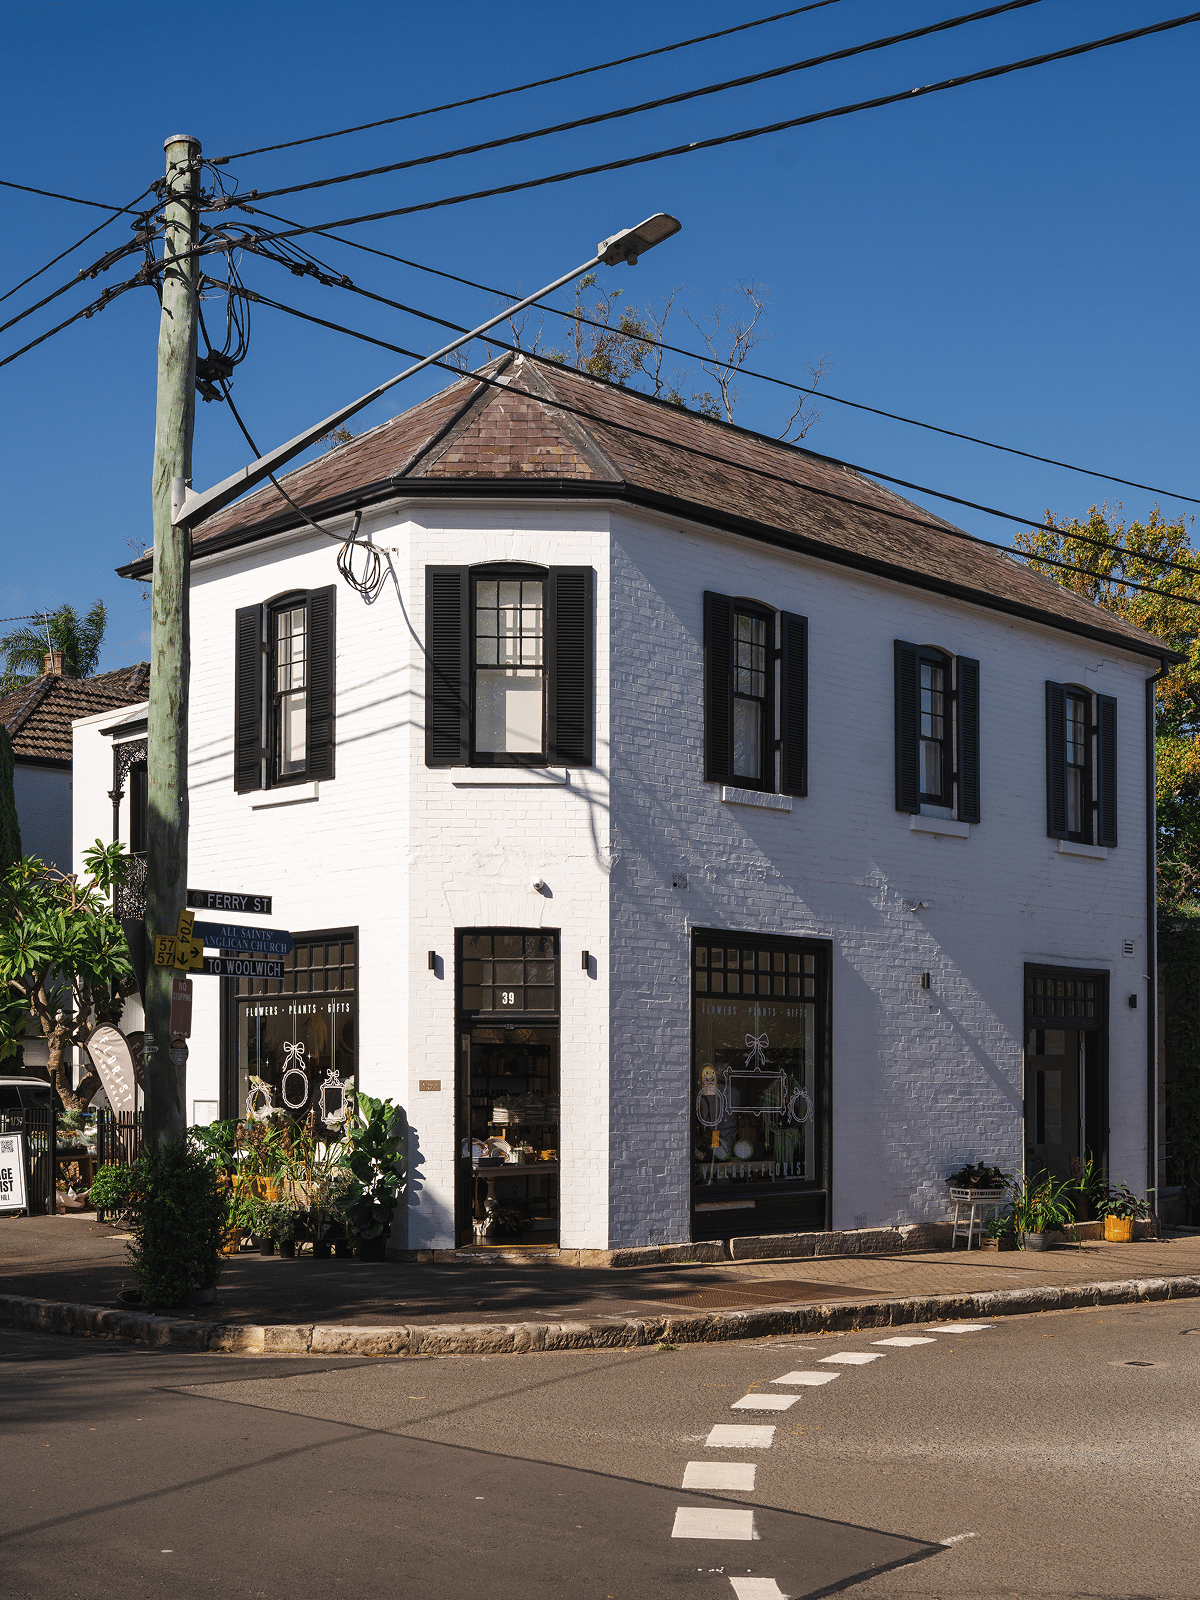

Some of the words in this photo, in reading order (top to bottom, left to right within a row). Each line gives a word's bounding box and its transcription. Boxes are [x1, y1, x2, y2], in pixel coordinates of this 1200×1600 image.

[207, 893, 248, 910] FERRY
[253, 897, 269, 912] ST
[180, 919, 193, 944] 704
[221, 926, 238, 937] ALL
[204, 935, 249, 950] ANGLICAN
[250, 939, 288, 953] CHURCH
[208, 959, 222, 974] TO
[226, 960, 282, 977] WOOLWICH
[178, 981, 187, 991] NO
[172, 991, 192, 1002] STOPPING
[501, 991, 515, 1005] 39
[245, 1005, 278, 1017] FLOWERS
[288, 1003, 317, 1015] PLANTS
[327, 1002, 350, 1013] GIFTS
[701, 1004, 737, 1015] FLOWERS
[748, 1006, 776, 1017] PLANTS
[787, 1008, 808, 1018] GIFTS
[99, 1035, 132, 1103] FLORIST
[761, 1161, 808, 1177] FLORIST
